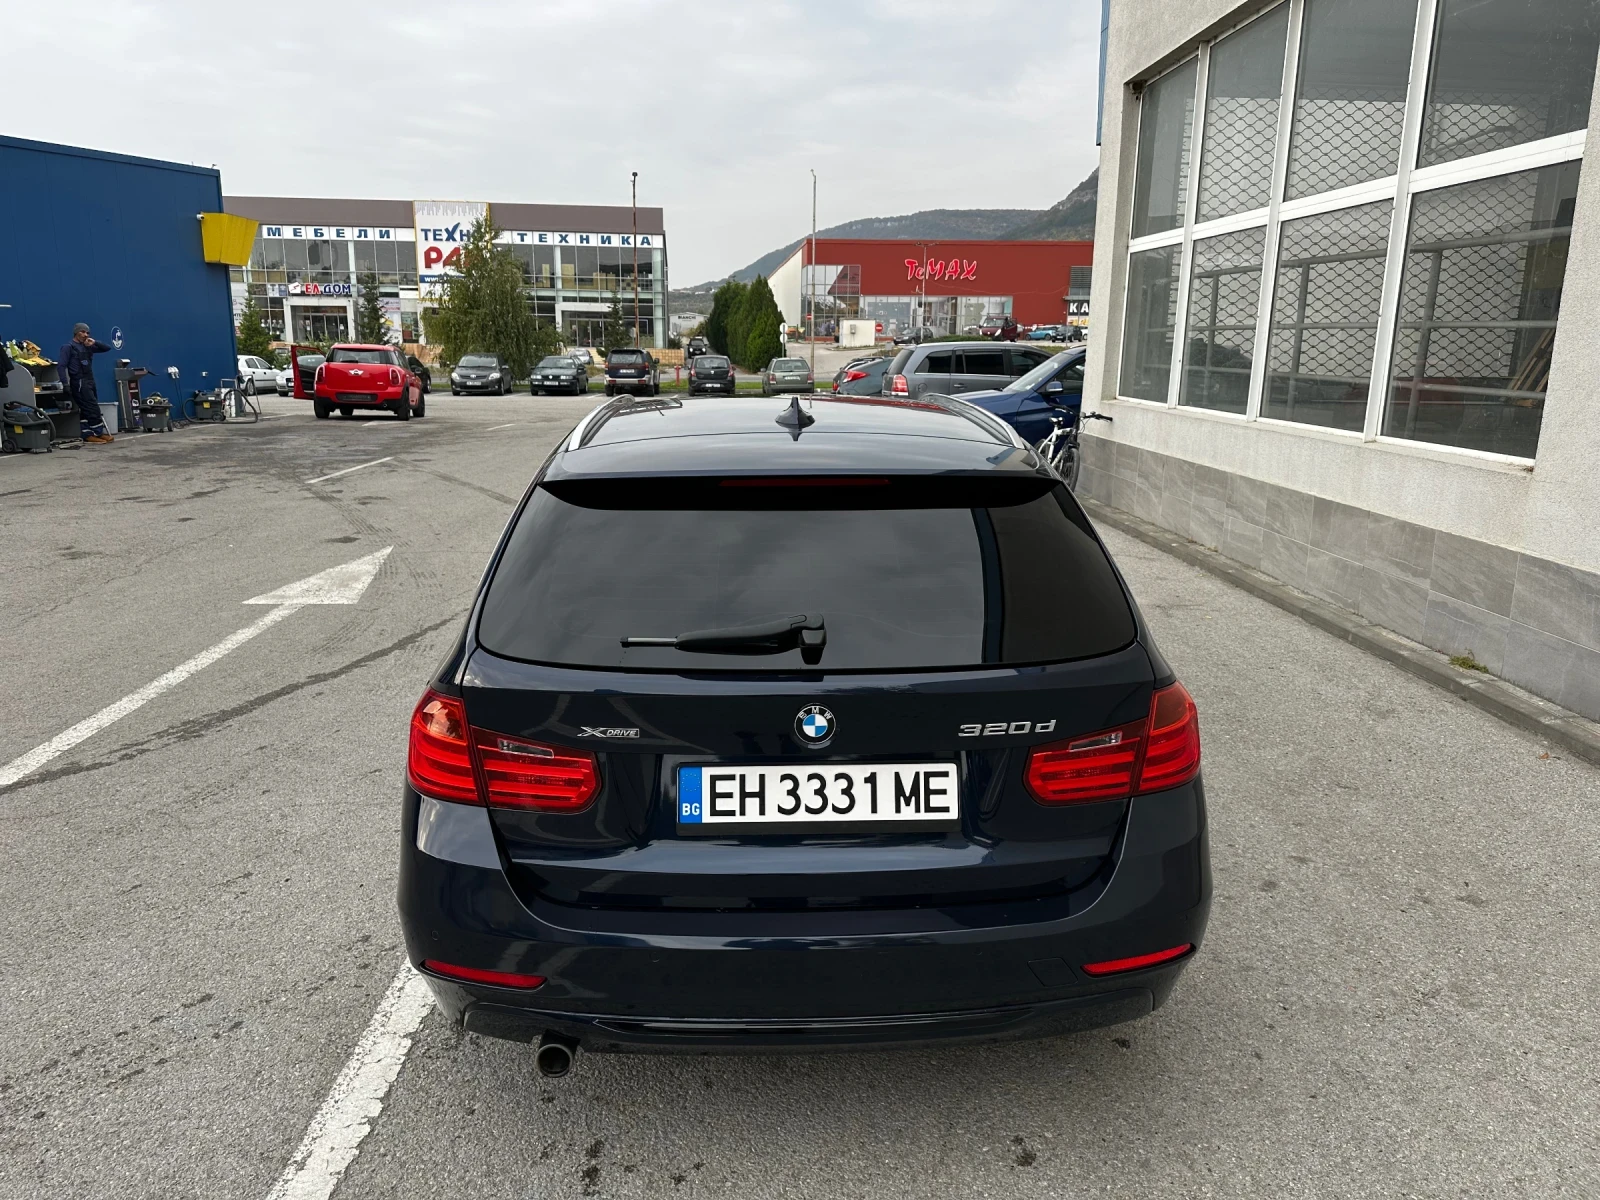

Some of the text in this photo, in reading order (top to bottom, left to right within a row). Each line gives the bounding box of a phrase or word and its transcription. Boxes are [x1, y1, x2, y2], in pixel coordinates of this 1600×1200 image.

[266, 227, 391, 239] МЕБЕЛИ
[421, 222, 473, 242] ТЕХН
[517, 232, 652, 246] ТЕХНИКА
[424, 246, 473, 269] РА
[305, 283, 352, 295] ЕЛ ДОМ
[798, 706, 832, 720] BMW
[958, 719, 1057, 737] 320d
[709, 771, 950, 817] EH 3331 ME
[682, 802, 700, 816] BG
